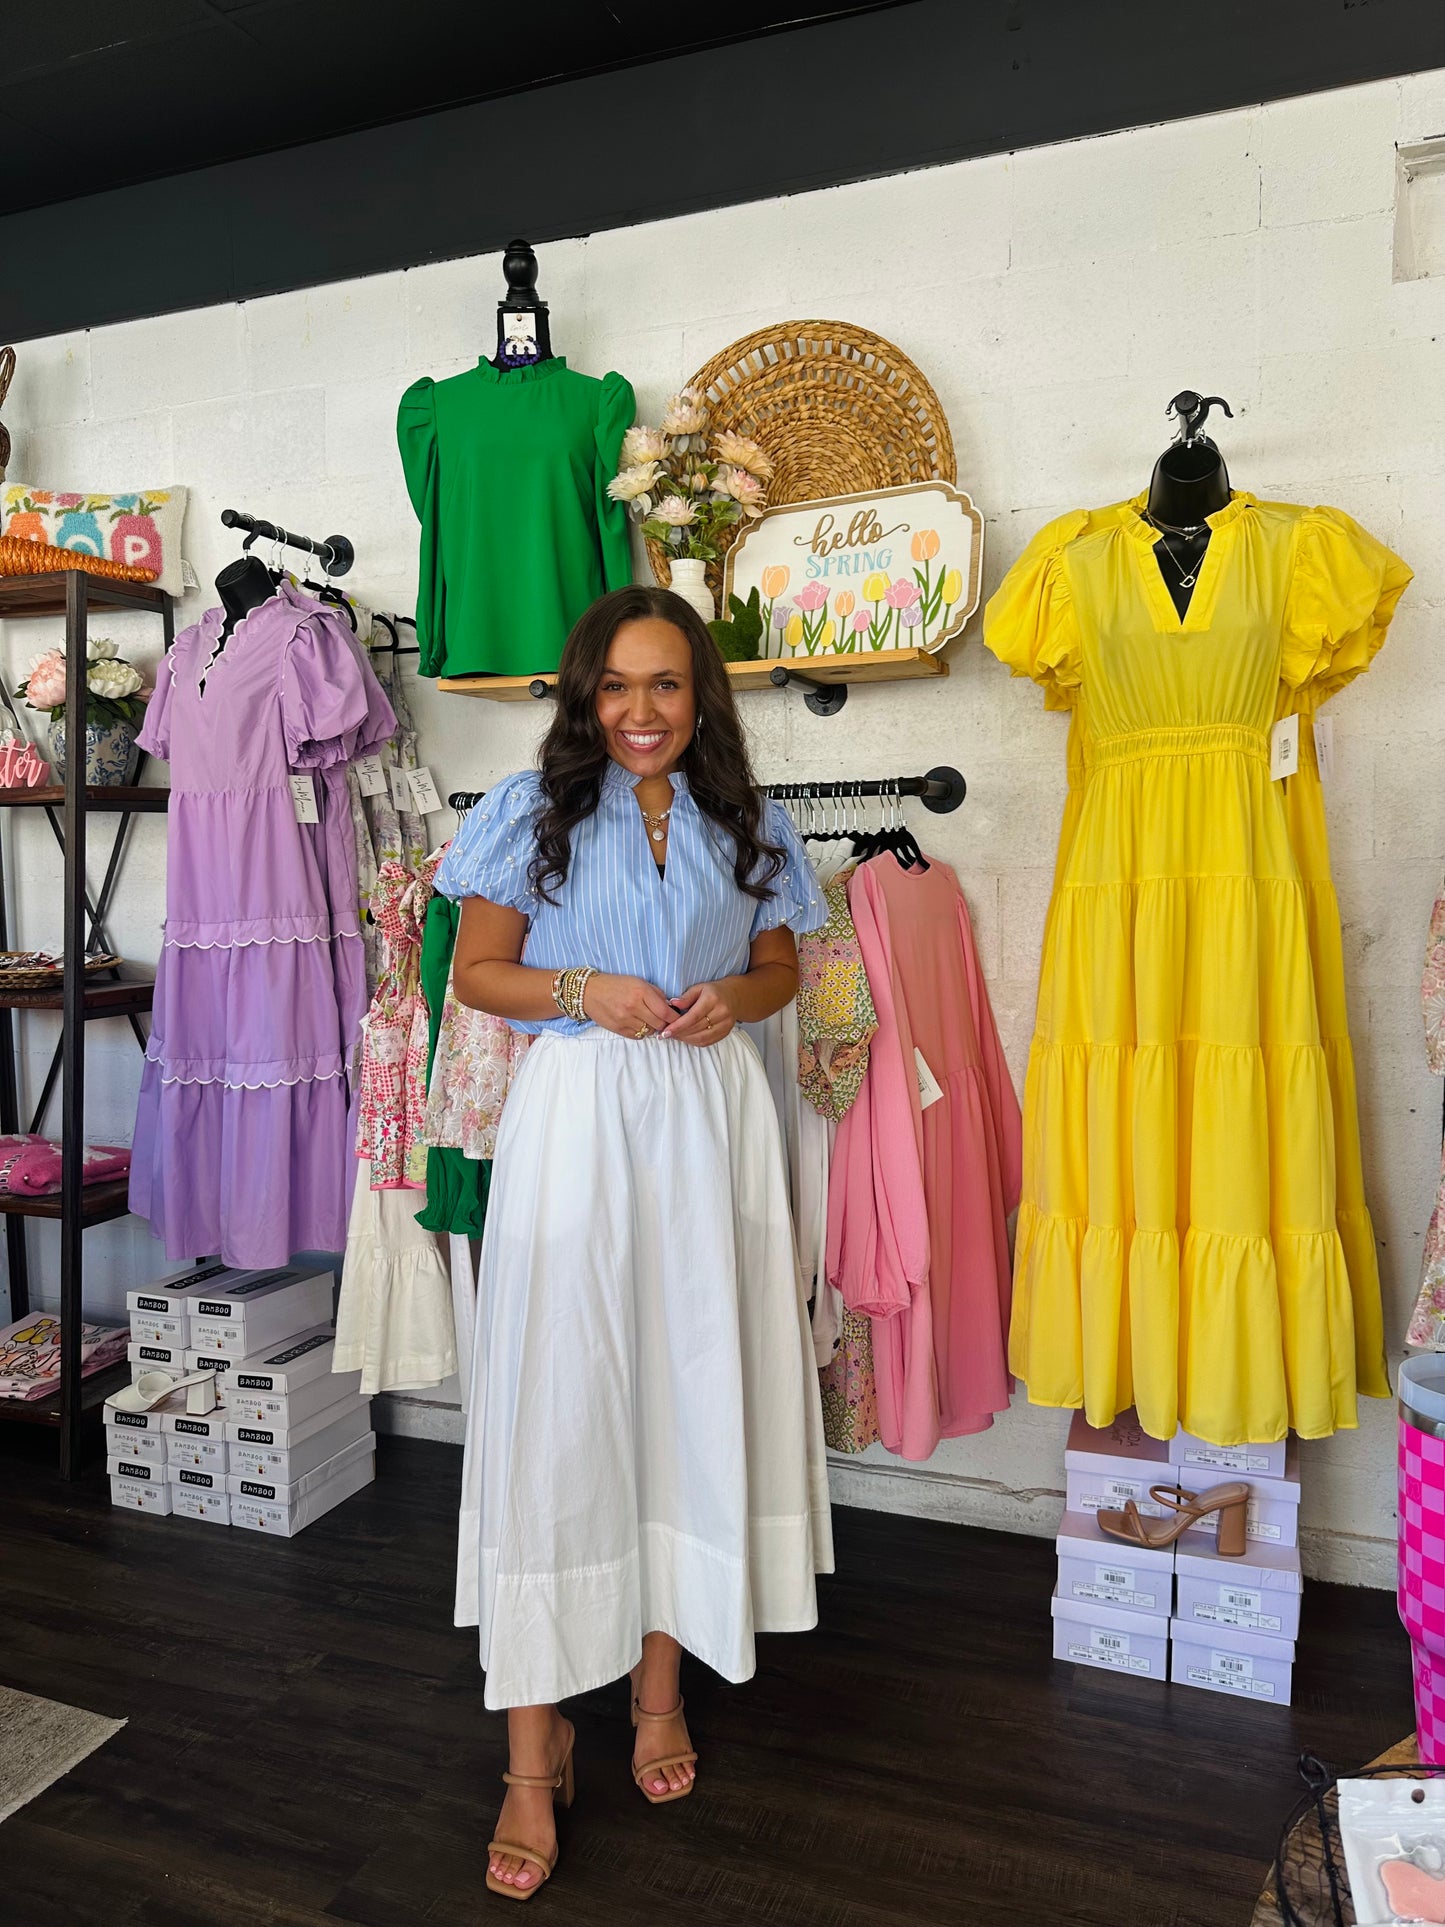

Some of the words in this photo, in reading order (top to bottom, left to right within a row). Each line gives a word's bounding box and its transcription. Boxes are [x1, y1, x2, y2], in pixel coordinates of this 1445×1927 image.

[794, 509, 910, 557] hello
[805, 548, 893, 579] SPRING
[139, 1300, 167, 1310] BAMBOO
[200, 1304, 229, 1314] BAMBOO
[141, 1349, 169, 1360] BAMBOO
[199, 1360, 229, 1370] BAMBOO
[240, 1378, 271, 1387] BAMBOO
[116, 1415, 146, 1425] BAMBOO
[177, 1422, 207, 1433] BAMBOO
[240, 1431, 271, 1442] BAMBOO
[120, 1465, 149, 1477] BAMBOO
[181, 1473, 211, 1485] BAMBOO
[242, 1484, 273, 1497] BAMBOO
